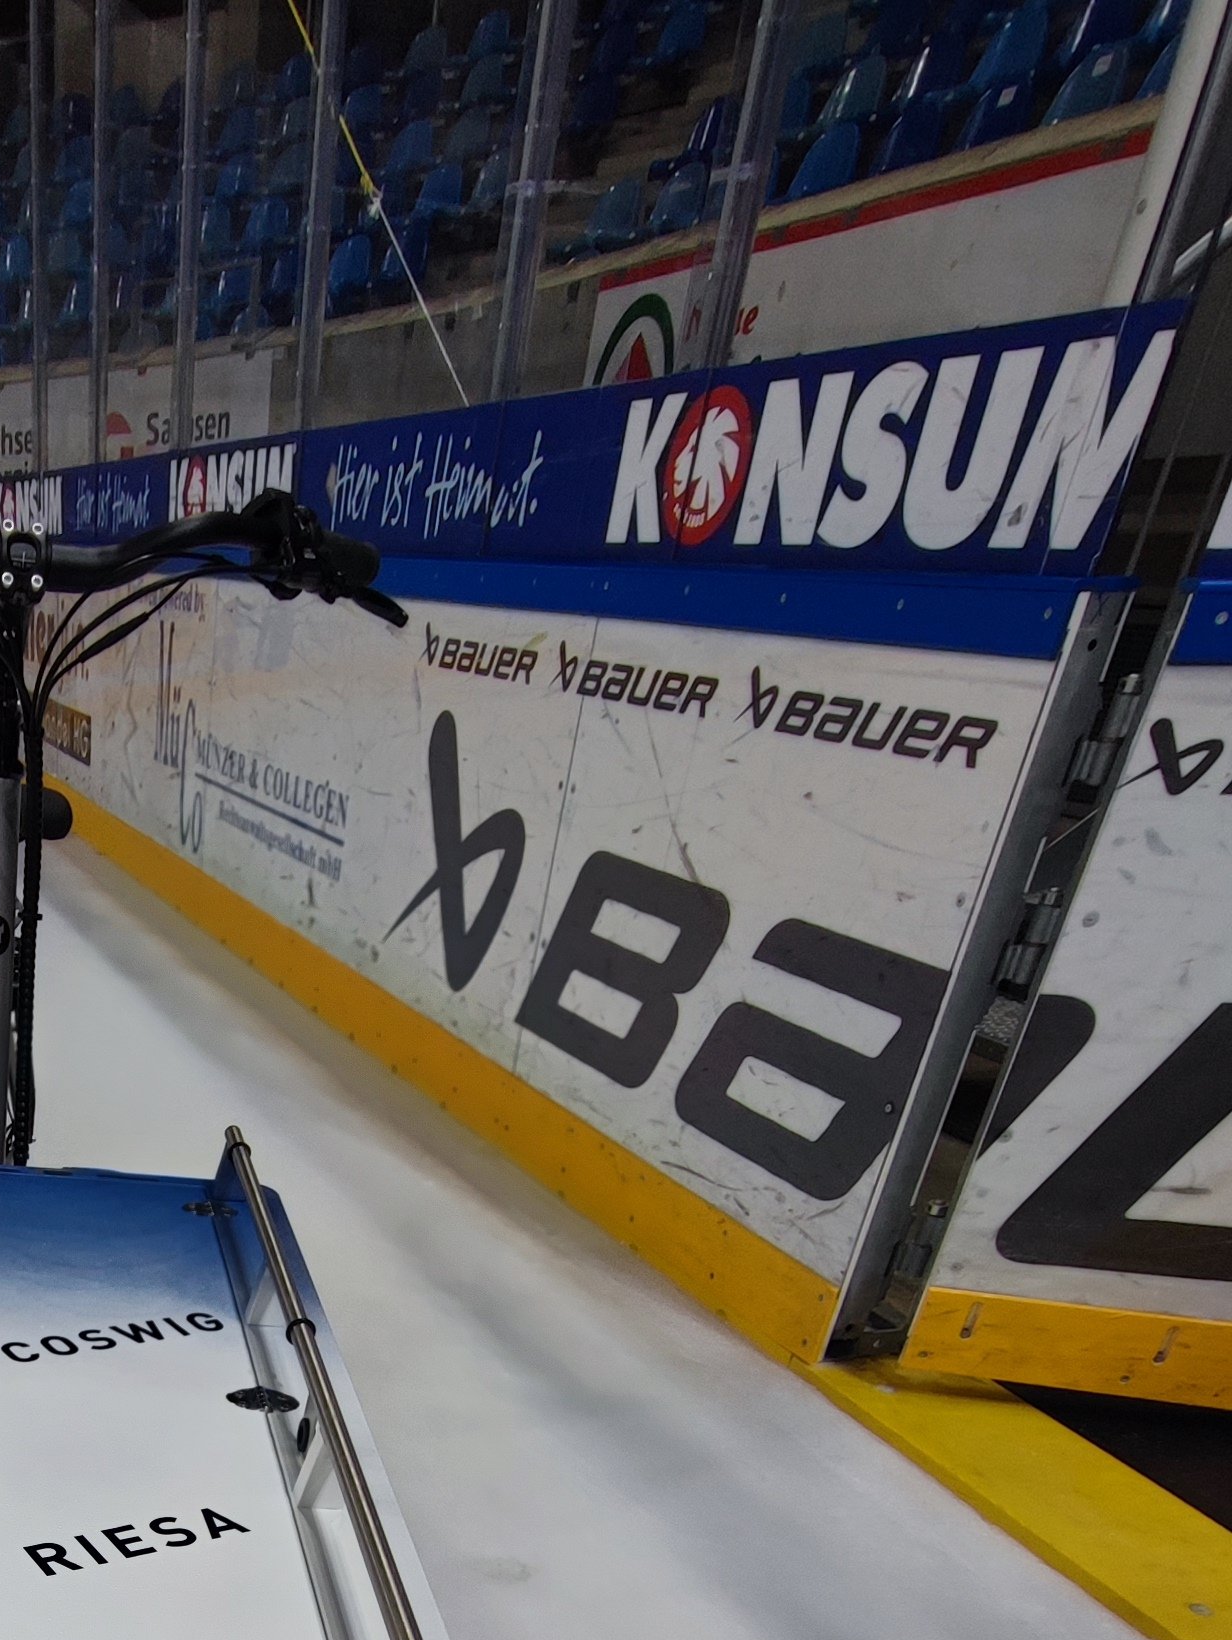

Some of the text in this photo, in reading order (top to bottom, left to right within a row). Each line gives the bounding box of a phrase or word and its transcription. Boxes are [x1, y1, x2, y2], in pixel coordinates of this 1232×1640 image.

[330, 442, 379, 532] Hier
[380, 431, 423, 528] ist
[248, 757, 259, 791] &
[263, 763, 350, 830] COLLEGEN
[1, 1311, 224, 1364] COSWIG
[23, 1507, 251, 1577] RIESA
